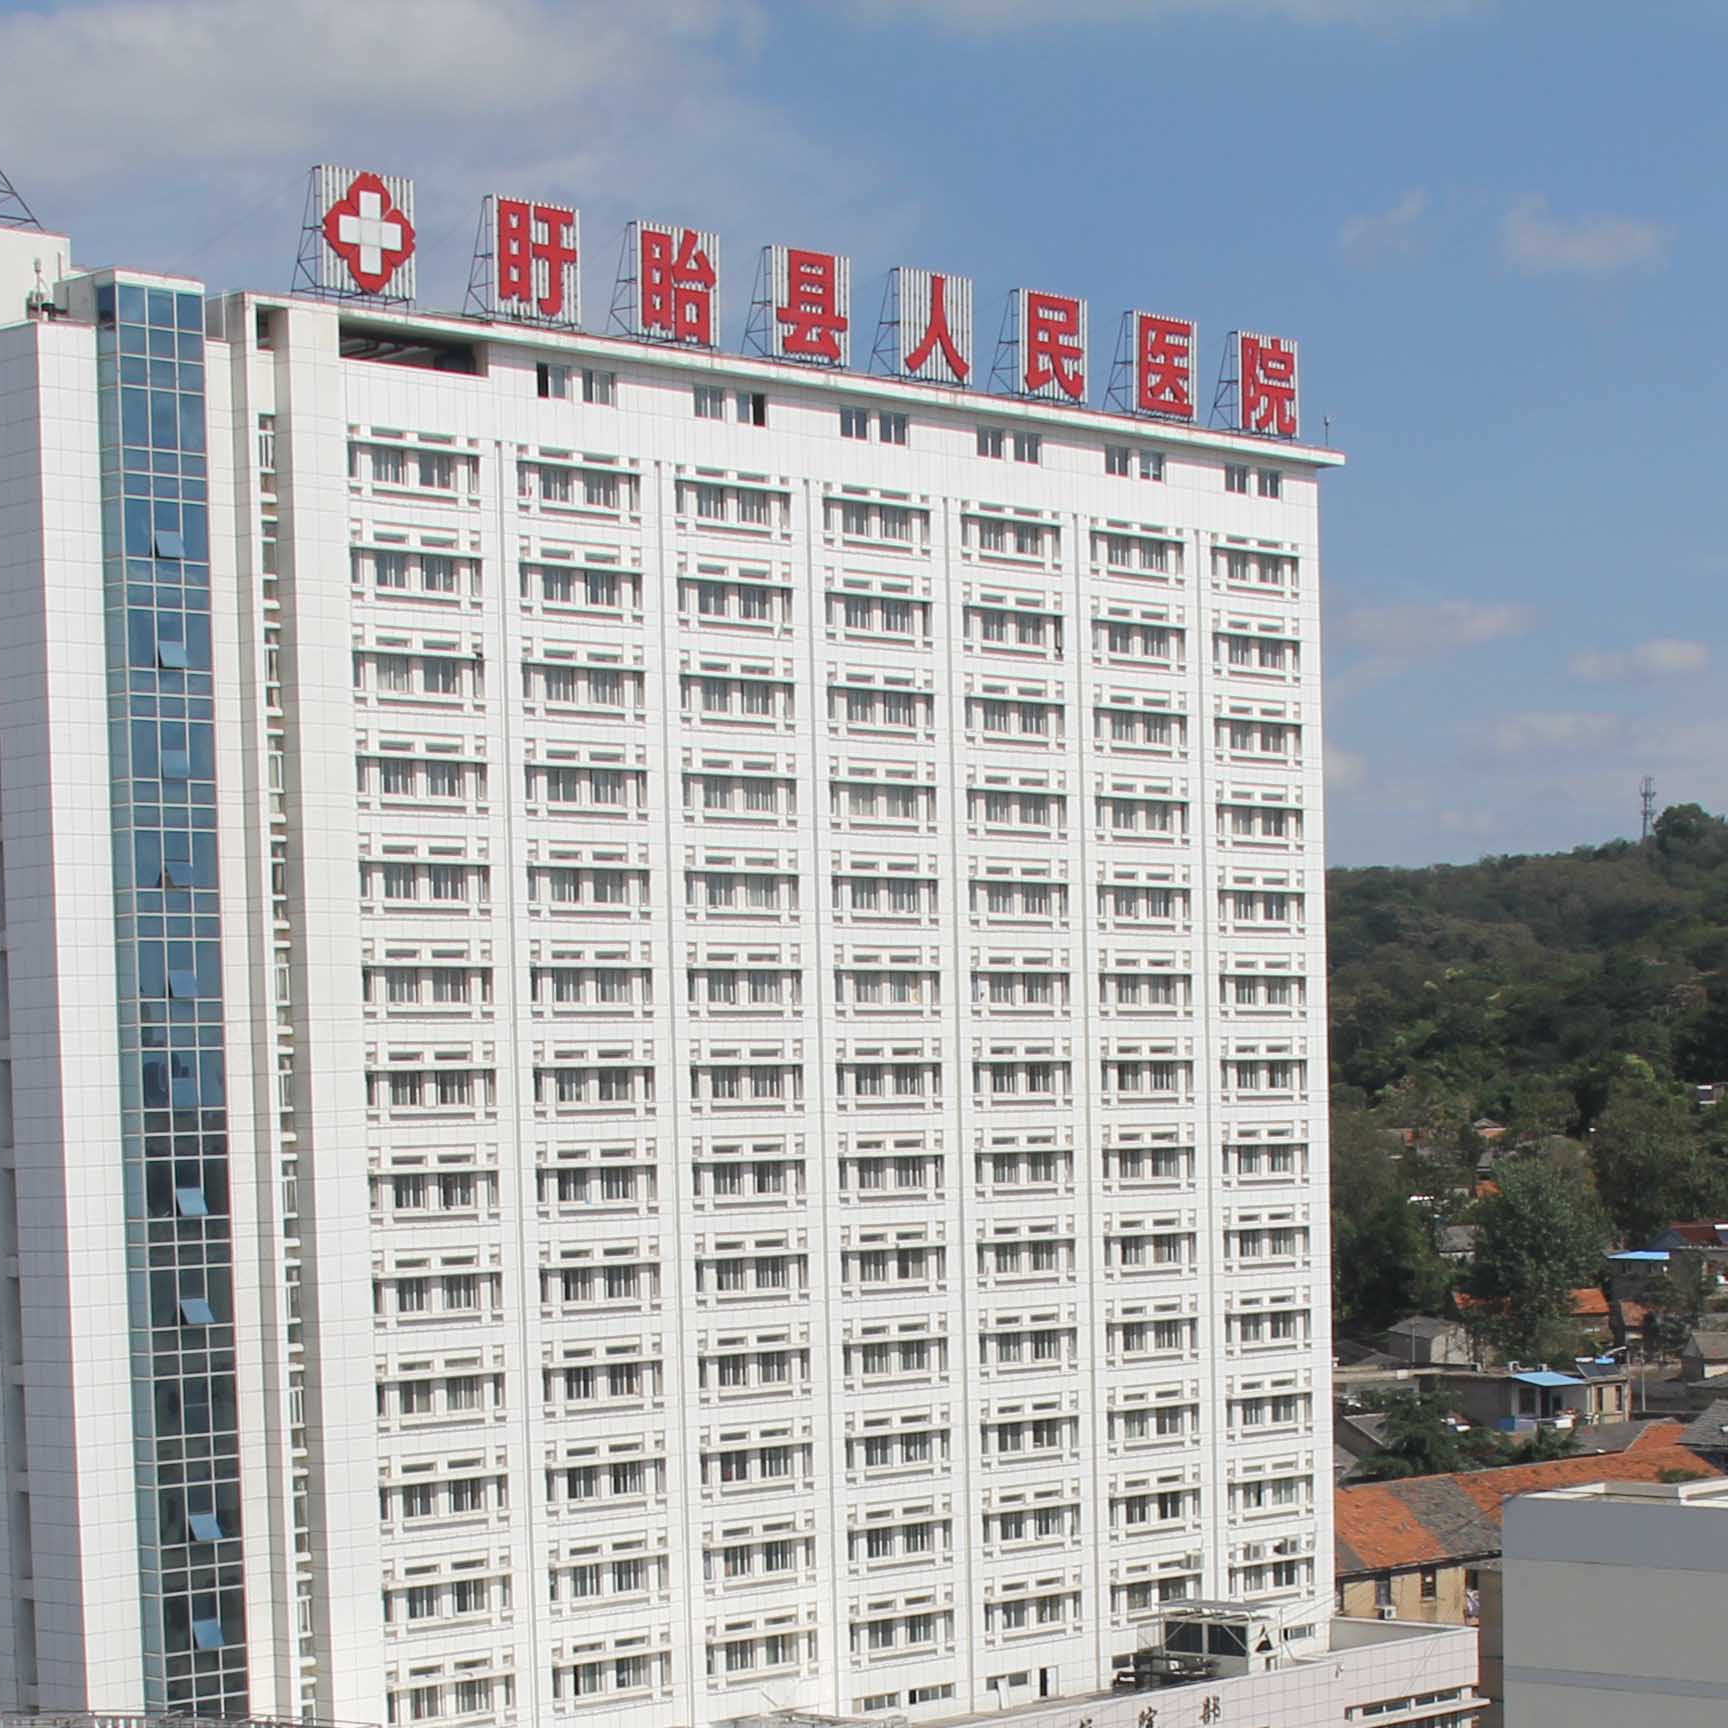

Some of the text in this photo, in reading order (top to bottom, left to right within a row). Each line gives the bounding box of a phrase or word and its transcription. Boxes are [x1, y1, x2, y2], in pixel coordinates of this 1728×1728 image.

[497, 199, 1296, 436] 盱眙县人民医院
